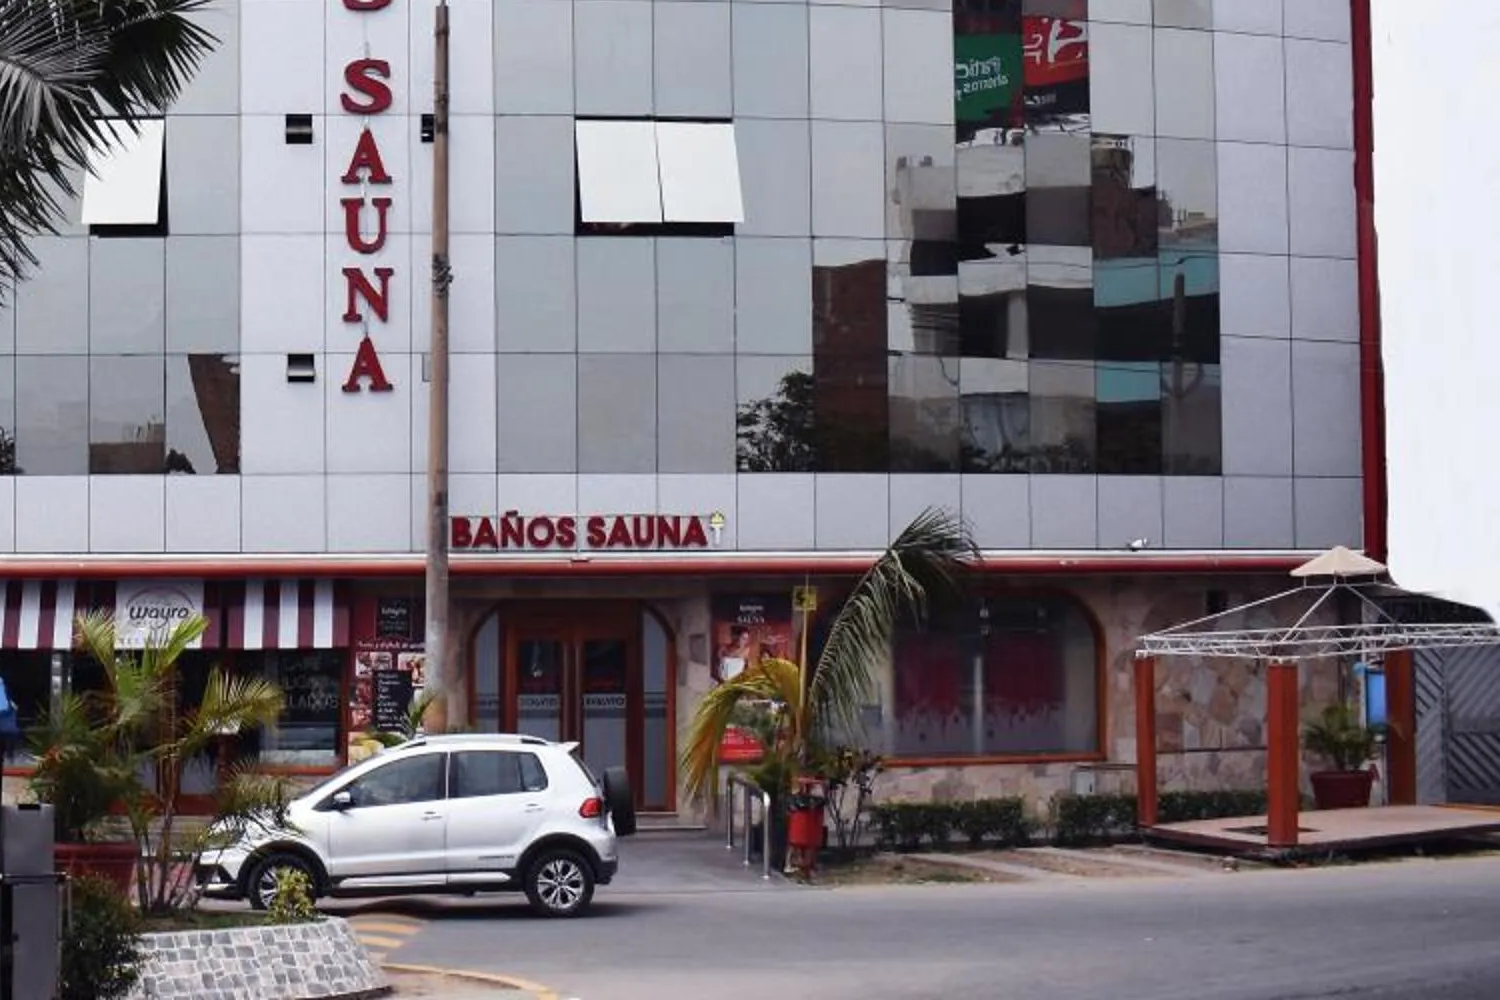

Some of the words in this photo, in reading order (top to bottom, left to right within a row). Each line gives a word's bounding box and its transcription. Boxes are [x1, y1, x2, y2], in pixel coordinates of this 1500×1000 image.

[339, 57, 394, 393] SAUNA
[450, 509, 577, 548] BAÑOS
[586, 514, 709, 548] SAUNA
